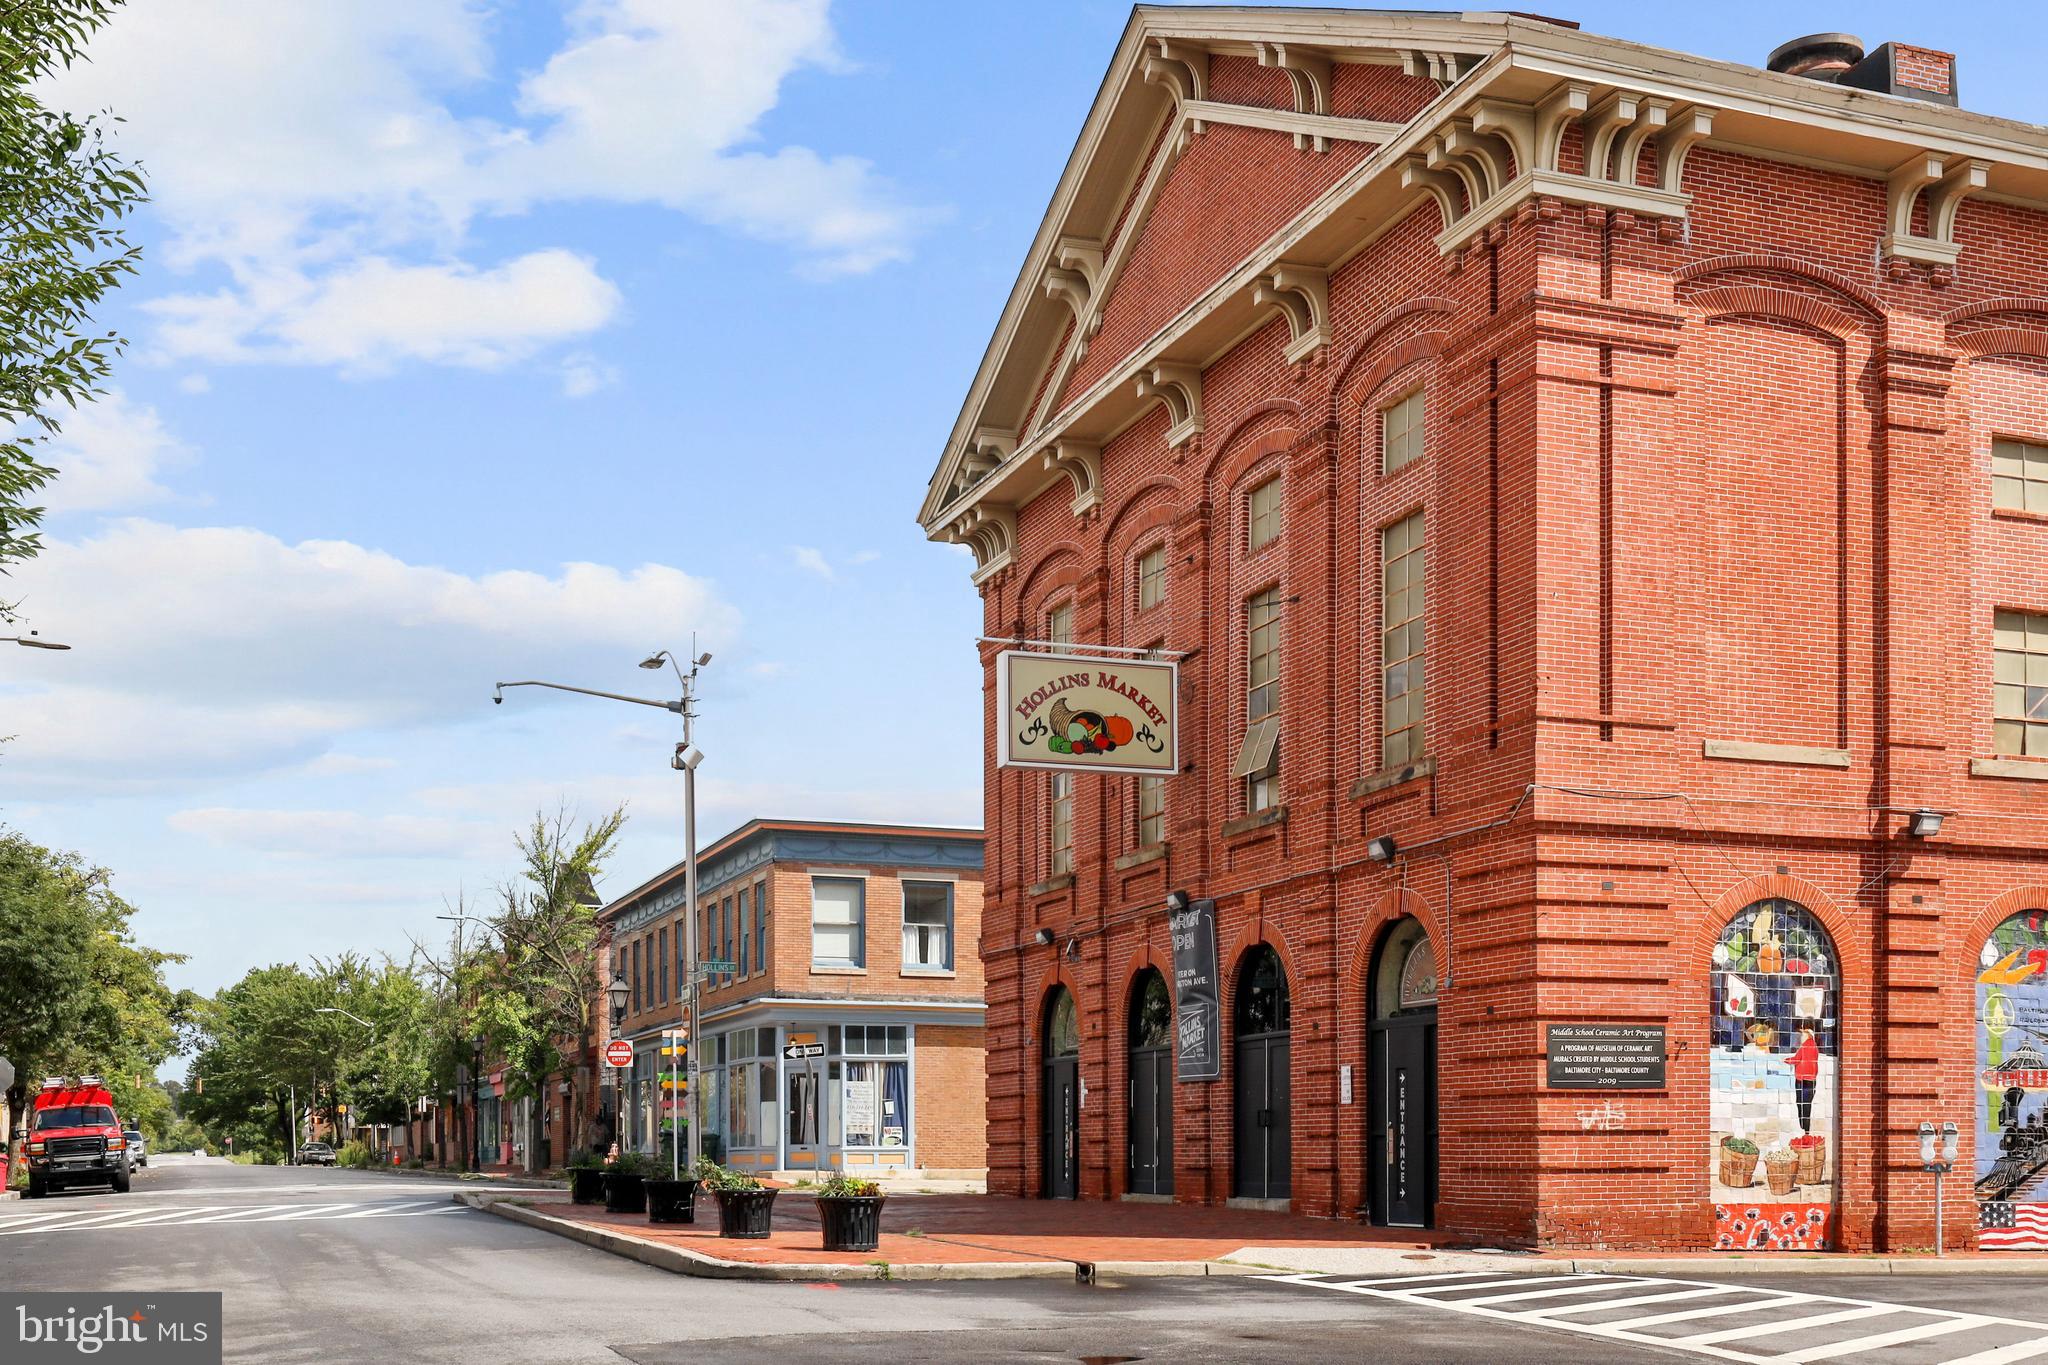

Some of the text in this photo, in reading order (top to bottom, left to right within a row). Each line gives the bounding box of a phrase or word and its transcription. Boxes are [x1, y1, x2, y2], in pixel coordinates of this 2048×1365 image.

[1015, 671, 1168, 727] HOLLINS MARKET
[702, 963, 729, 971] HOLLINS
[1550, 1028, 1573, 1036] Middle
[1574, 1028, 1594, 1036] School
[1595, 1028, 1620, 1036] Ceramic
[1635, 1029, 1662, 1038] Program
